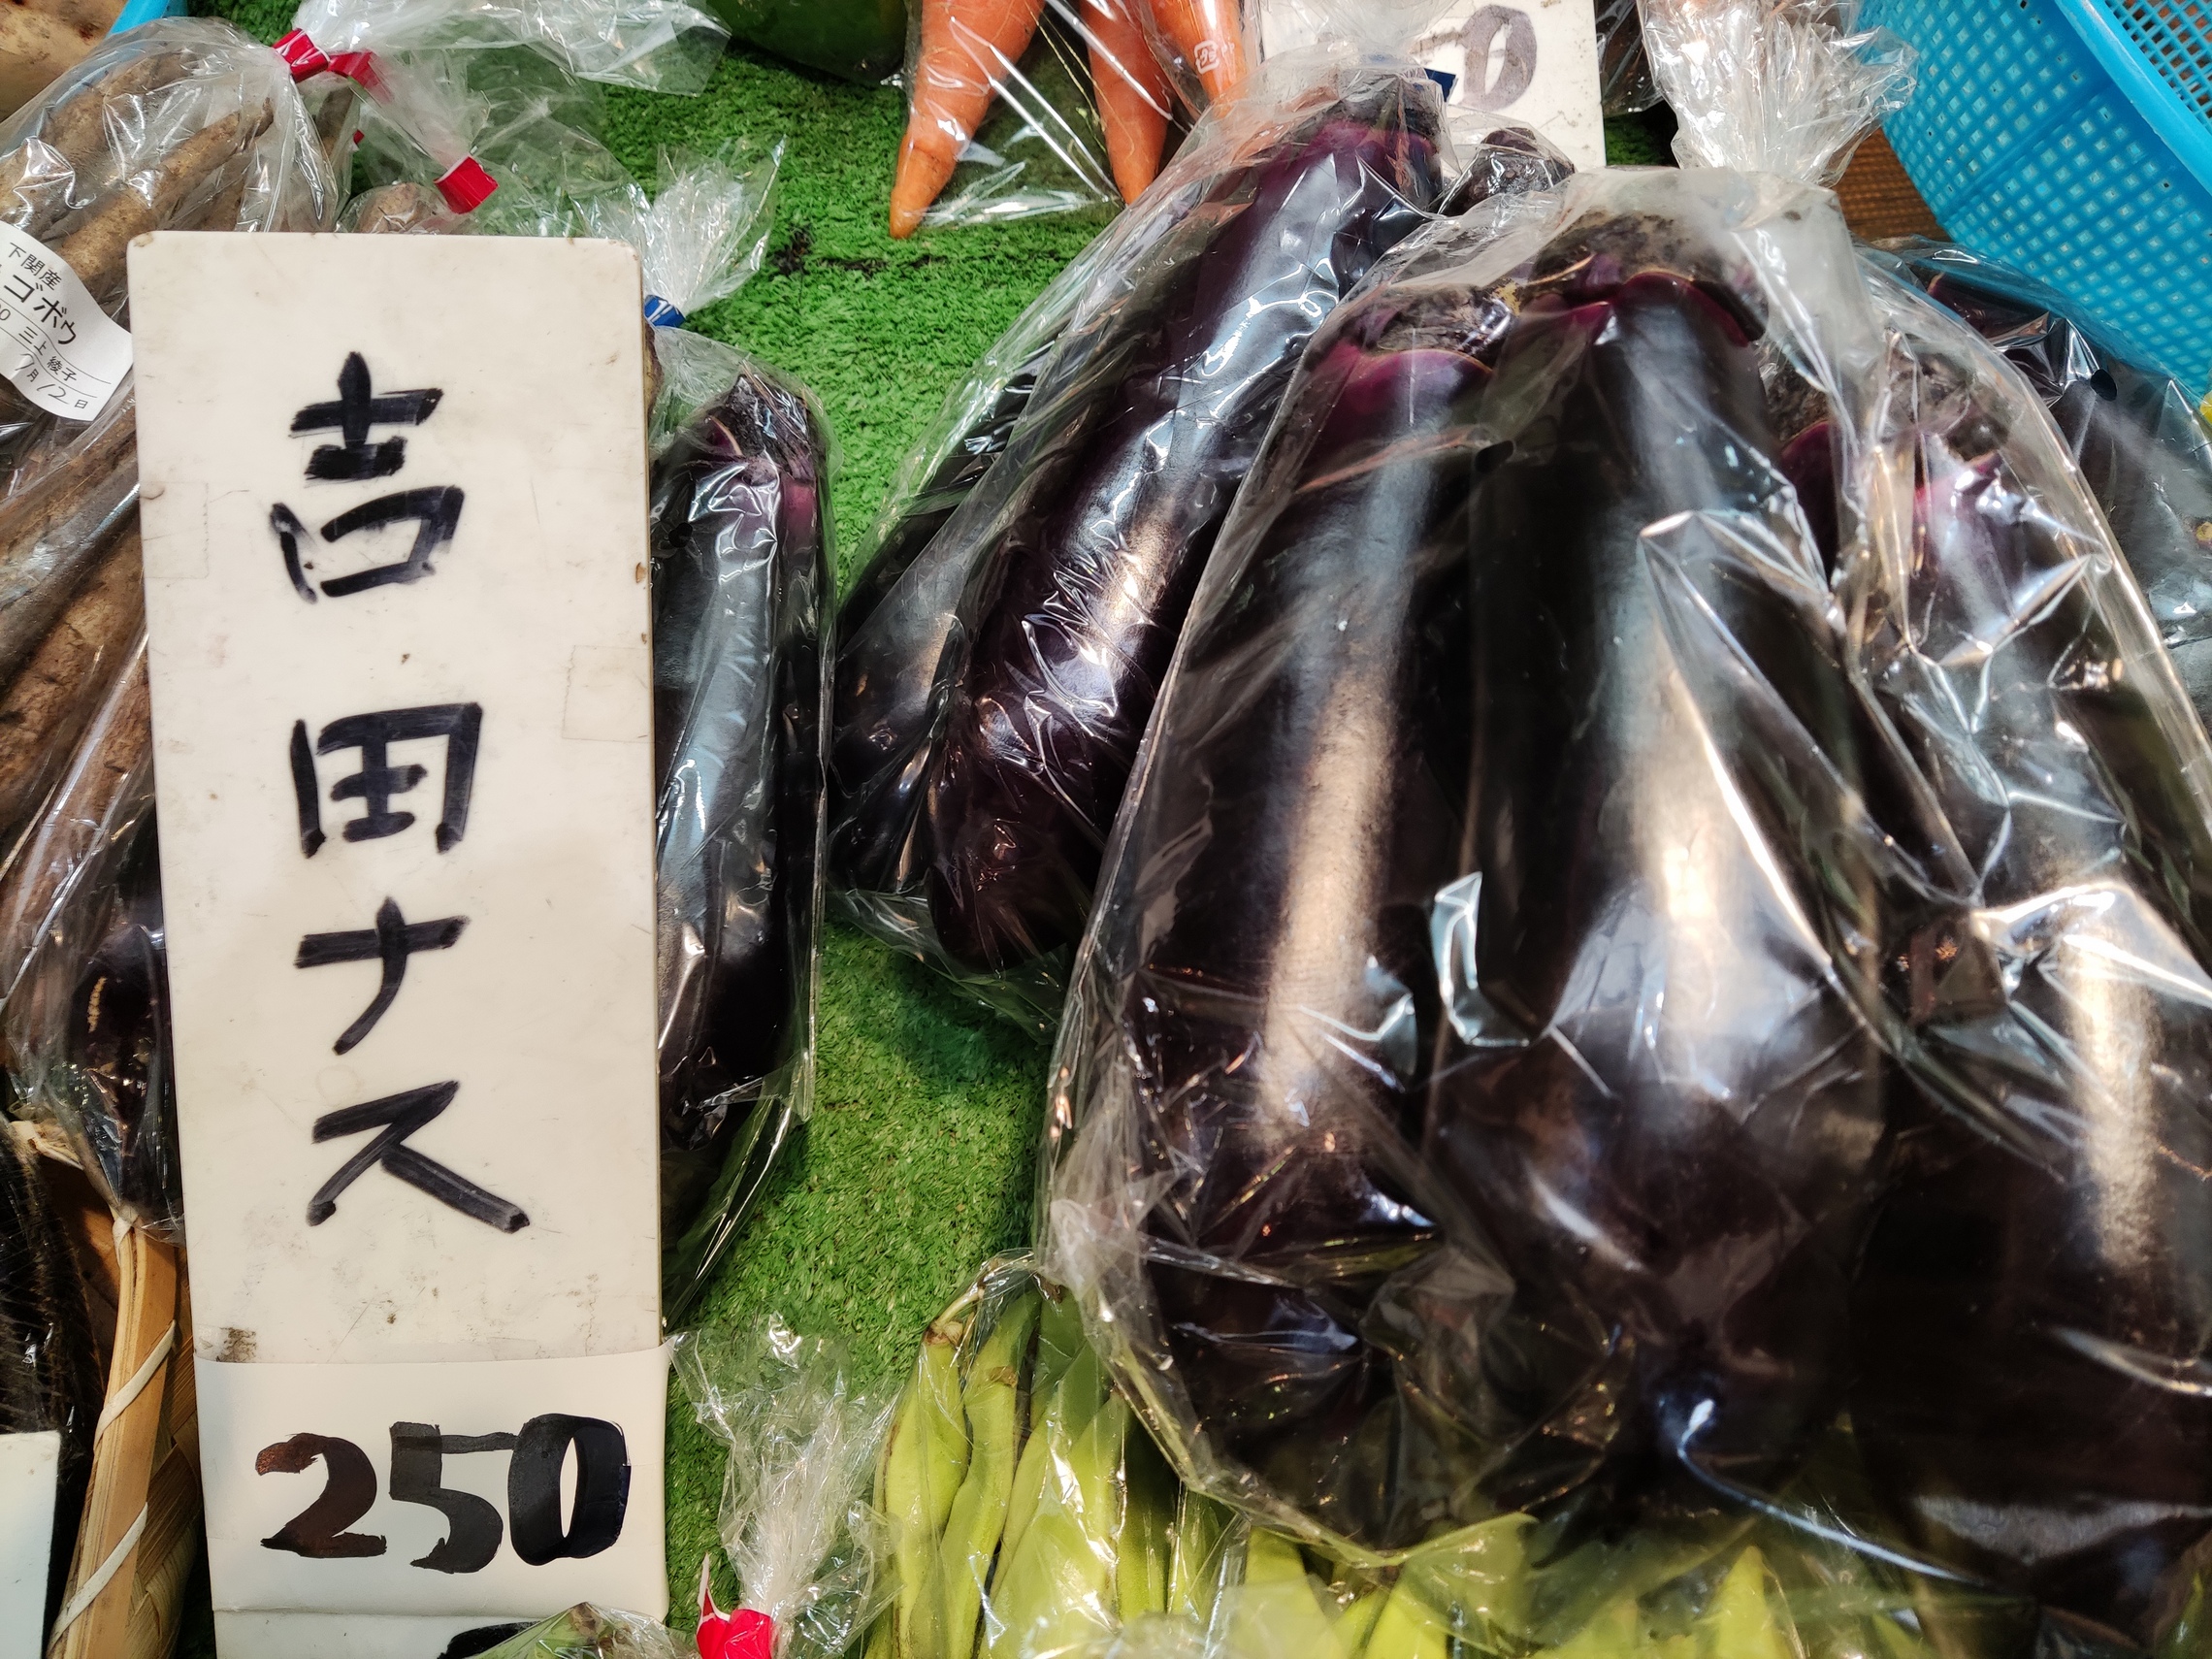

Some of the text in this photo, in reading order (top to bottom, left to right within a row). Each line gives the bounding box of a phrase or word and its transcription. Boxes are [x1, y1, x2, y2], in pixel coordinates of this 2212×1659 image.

[0, 264, 77, 345] ゴボウ
[8, 242, 62, 291] 下関産
[18, 326, 47, 356] 三上
[268, 350, 531, 1234] 吉田ナス
[254, 1413, 632, 1575] 250
